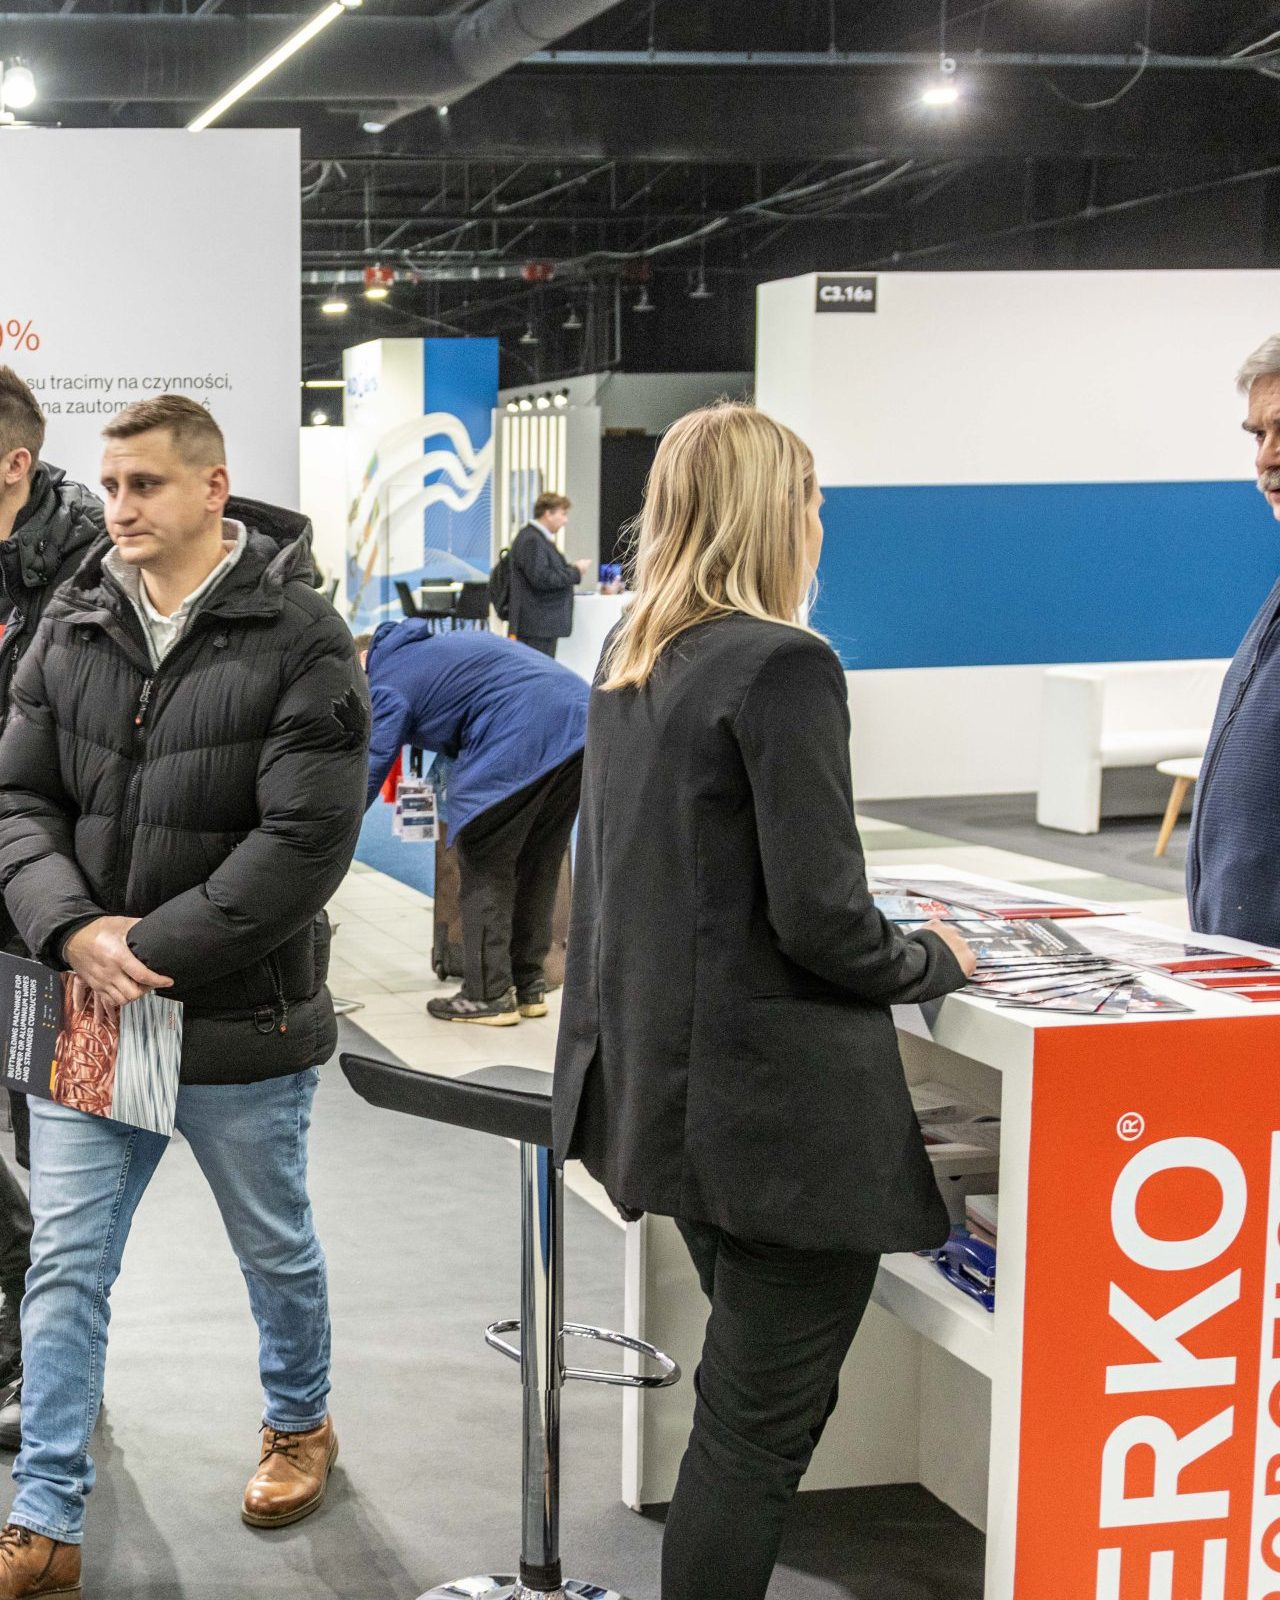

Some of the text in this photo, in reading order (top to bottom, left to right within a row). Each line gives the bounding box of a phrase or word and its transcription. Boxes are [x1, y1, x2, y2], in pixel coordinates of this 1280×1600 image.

[819, 285, 873, 302] C3.16a
[51, 374, 113, 392] tracimy
[118, 377, 138, 389] na
[142, 373, 233, 392] czynności,
[15, 974, 23, 989] FOR
[22, 975, 30, 997] WIRES
[12, 989, 22, 1027] MACHINES
[22, 979, 37, 1083] AND STRANDED CONDUCTORS
[18, 1040, 26, 1051] OR
[14, 1051, 23, 1080] COPPER
